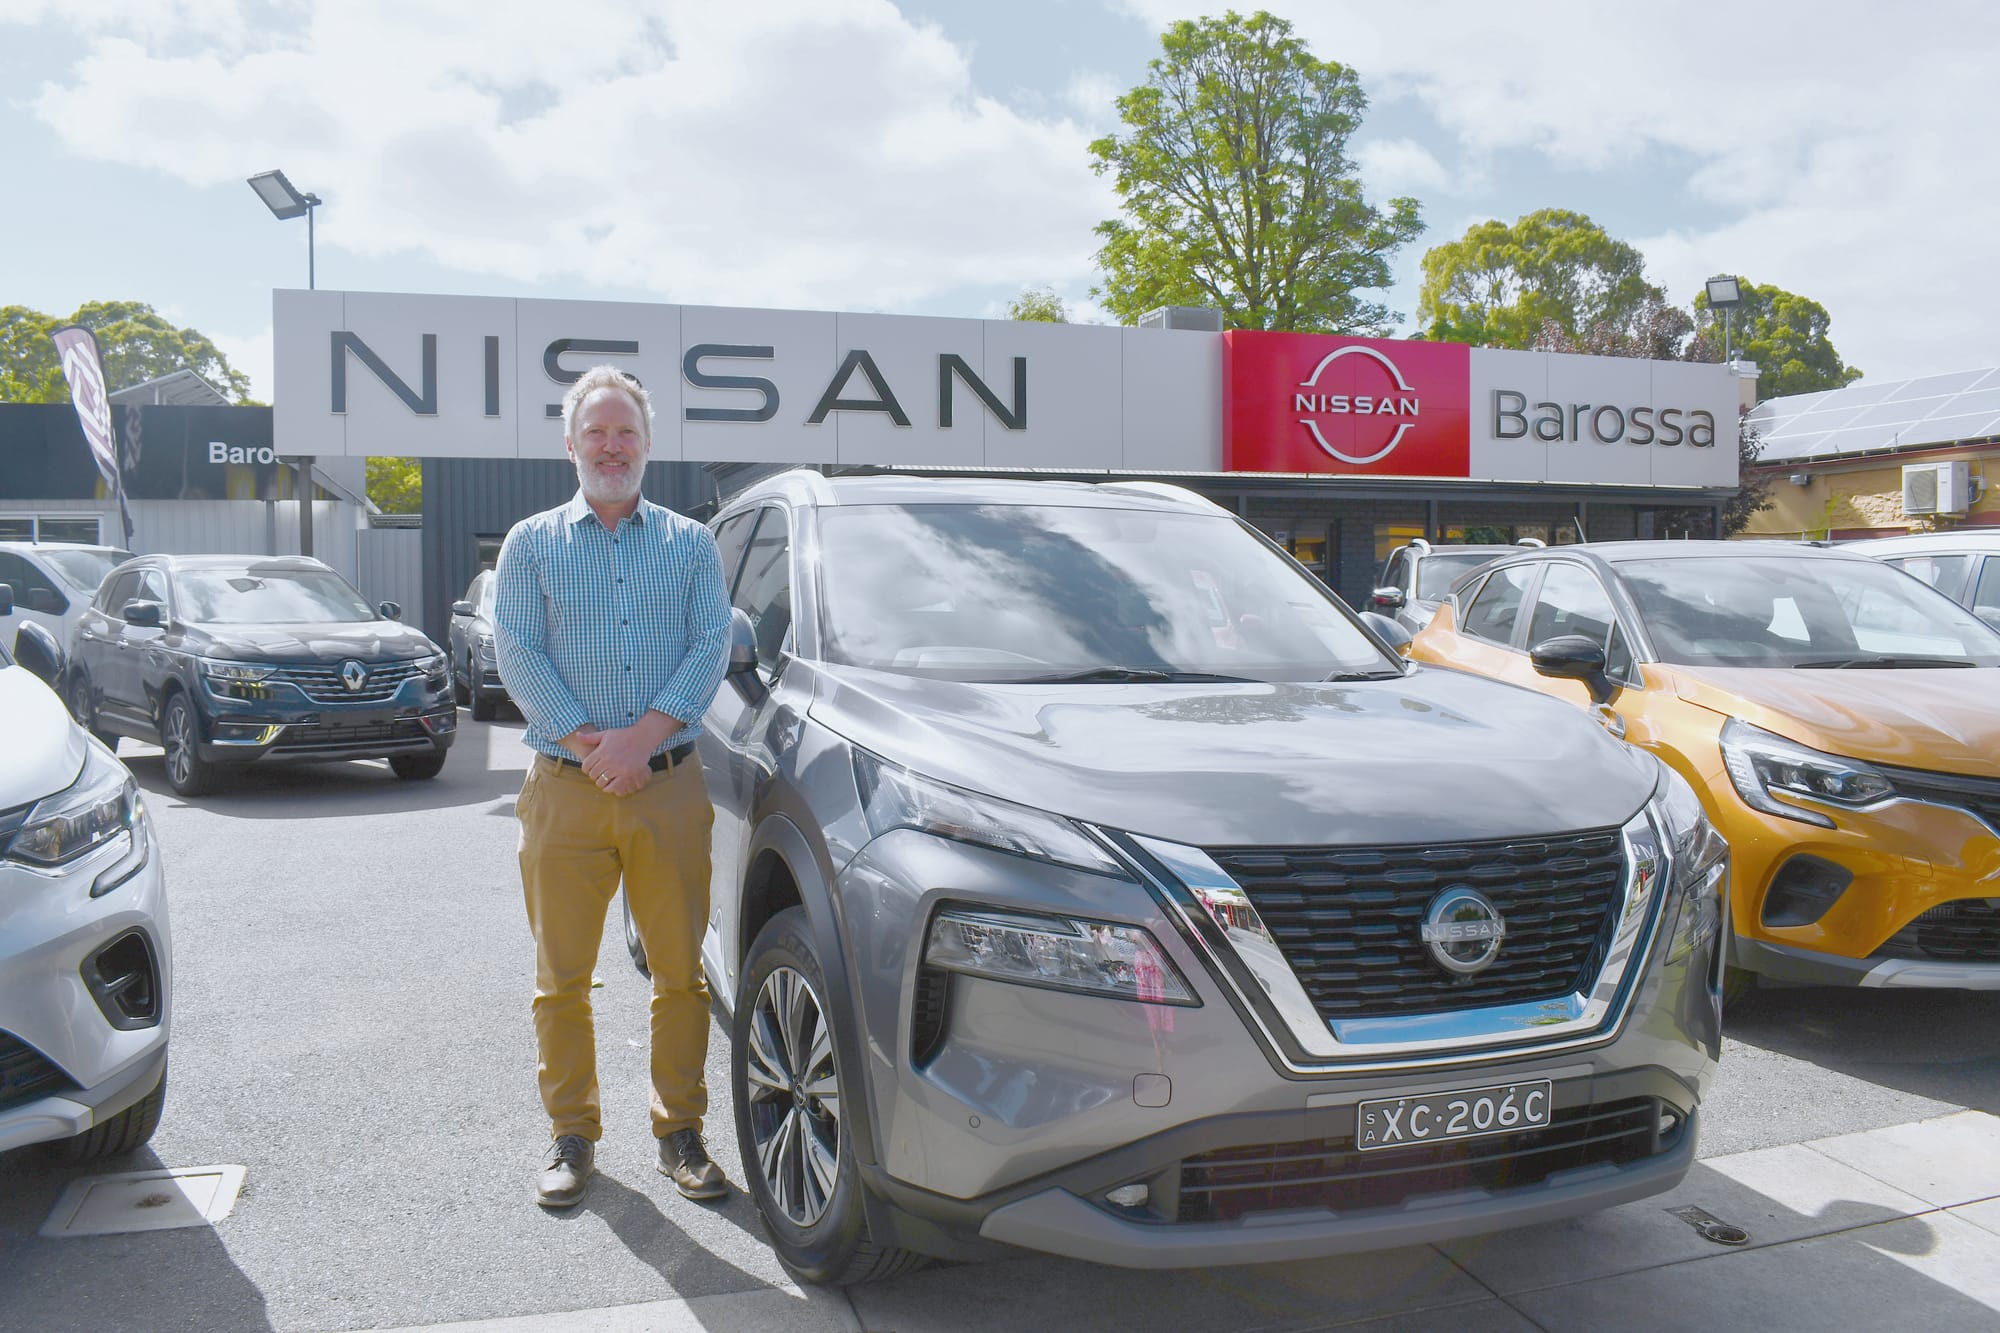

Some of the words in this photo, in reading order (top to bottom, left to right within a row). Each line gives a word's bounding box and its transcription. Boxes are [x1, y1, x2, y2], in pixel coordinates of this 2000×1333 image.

[1295, 393, 1419, 416] NISSAN
[1493, 389, 1716, 448] Barossa
[208, 441, 285, 465] Baro
[1422, 917, 1506, 940] NISSAN
